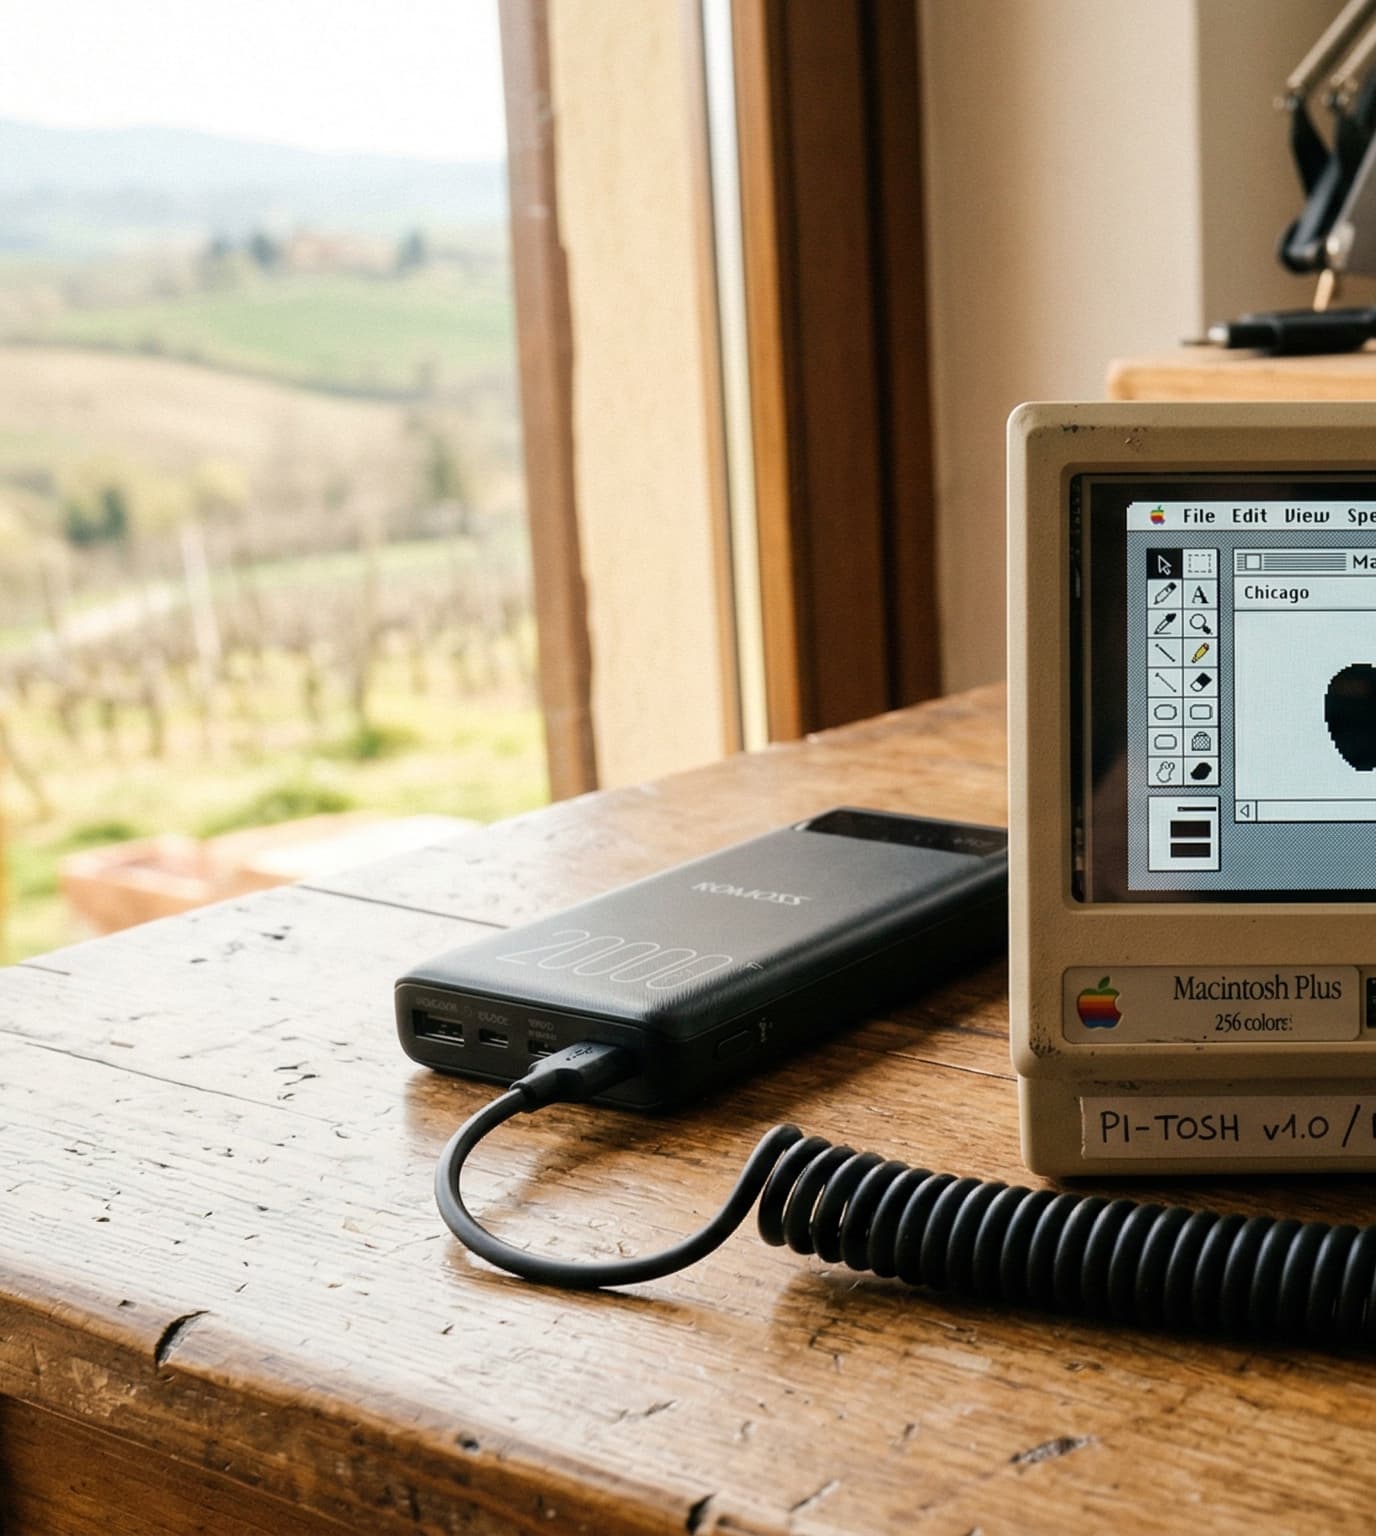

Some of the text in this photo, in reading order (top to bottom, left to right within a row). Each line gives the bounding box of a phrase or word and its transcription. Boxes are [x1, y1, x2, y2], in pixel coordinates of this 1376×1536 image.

[1184, 509, 1215, 523] File
[1233, 508, 1267, 522] Edit
[1286, 508, 1329, 522] View
[1245, 585, 1309, 603] Chicago
[1174, 974, 1341, 1000] Macintosh Plus
[1216, 1013, 1241, 1032] 256
[1101, 1111, 1239, 1143] PI-TOSH
[1263, 1114, 1329, 1140] v1.0
[1342, 1104, 1360, 1147] /
